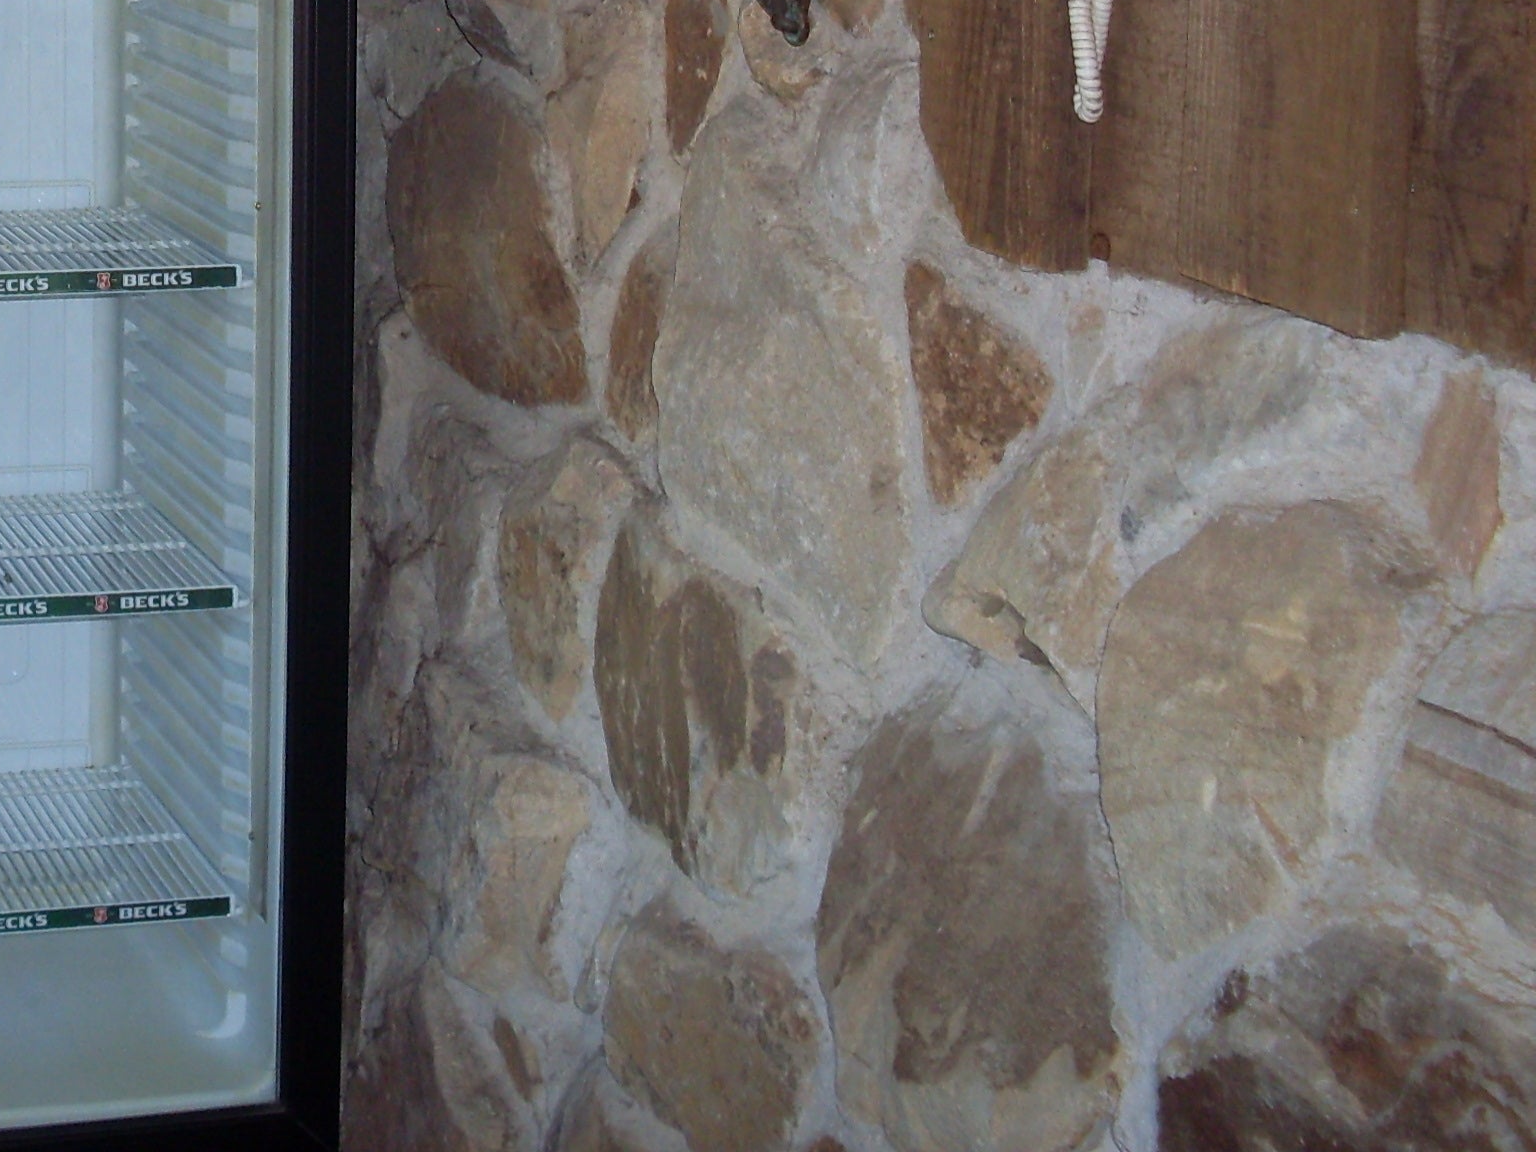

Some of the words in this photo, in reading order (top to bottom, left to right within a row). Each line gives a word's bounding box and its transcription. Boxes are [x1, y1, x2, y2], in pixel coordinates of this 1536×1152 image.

[122, 269, 193, 287] BECK'S
[119, 591, 190, 609] BECK'S
[118, 902, 188, 920] BECK'S
